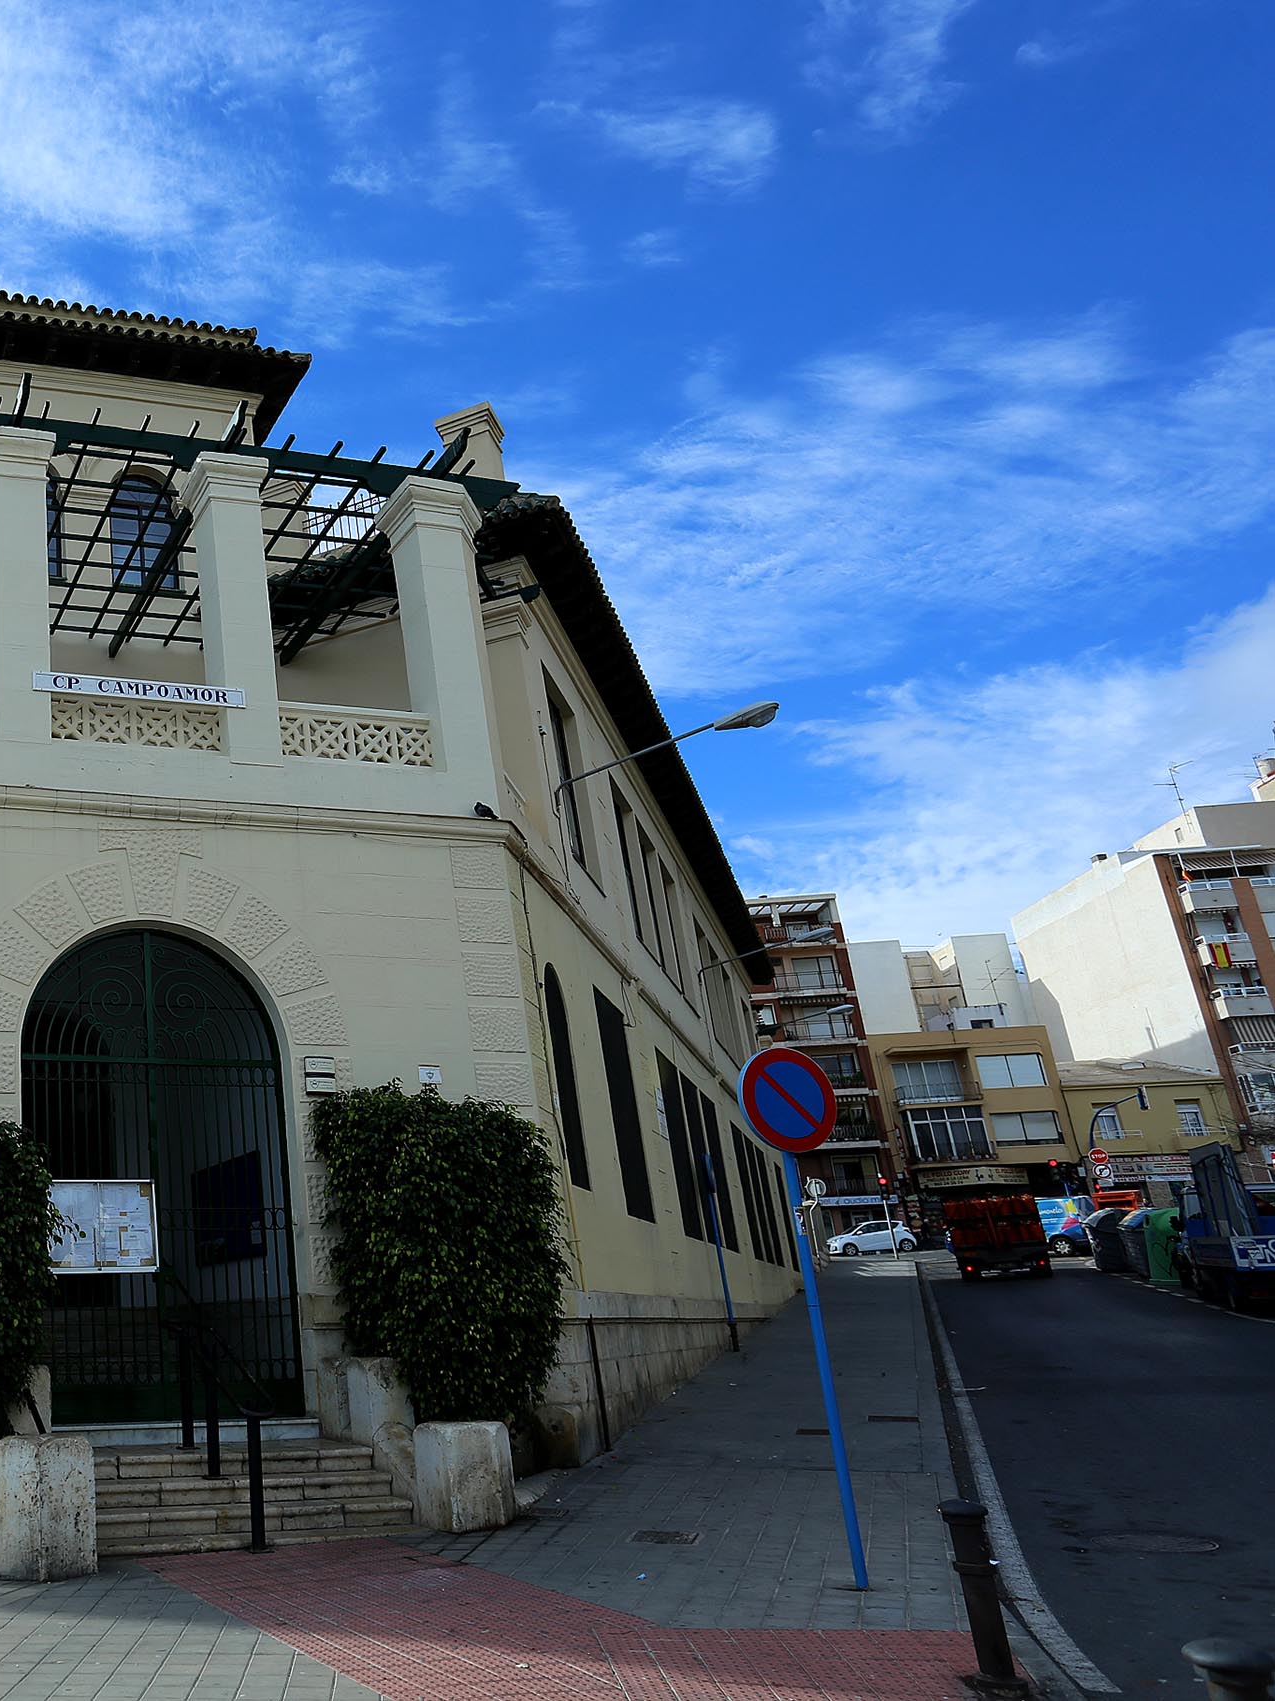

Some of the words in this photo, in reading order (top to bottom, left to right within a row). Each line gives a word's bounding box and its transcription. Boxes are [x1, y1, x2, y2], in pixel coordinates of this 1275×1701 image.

[52, 675, 82, 690] C.P.
[97, 679, 228, 703] CAMPOAMOR
[1108, 1155, 1171, 1163] ERRAJERO
